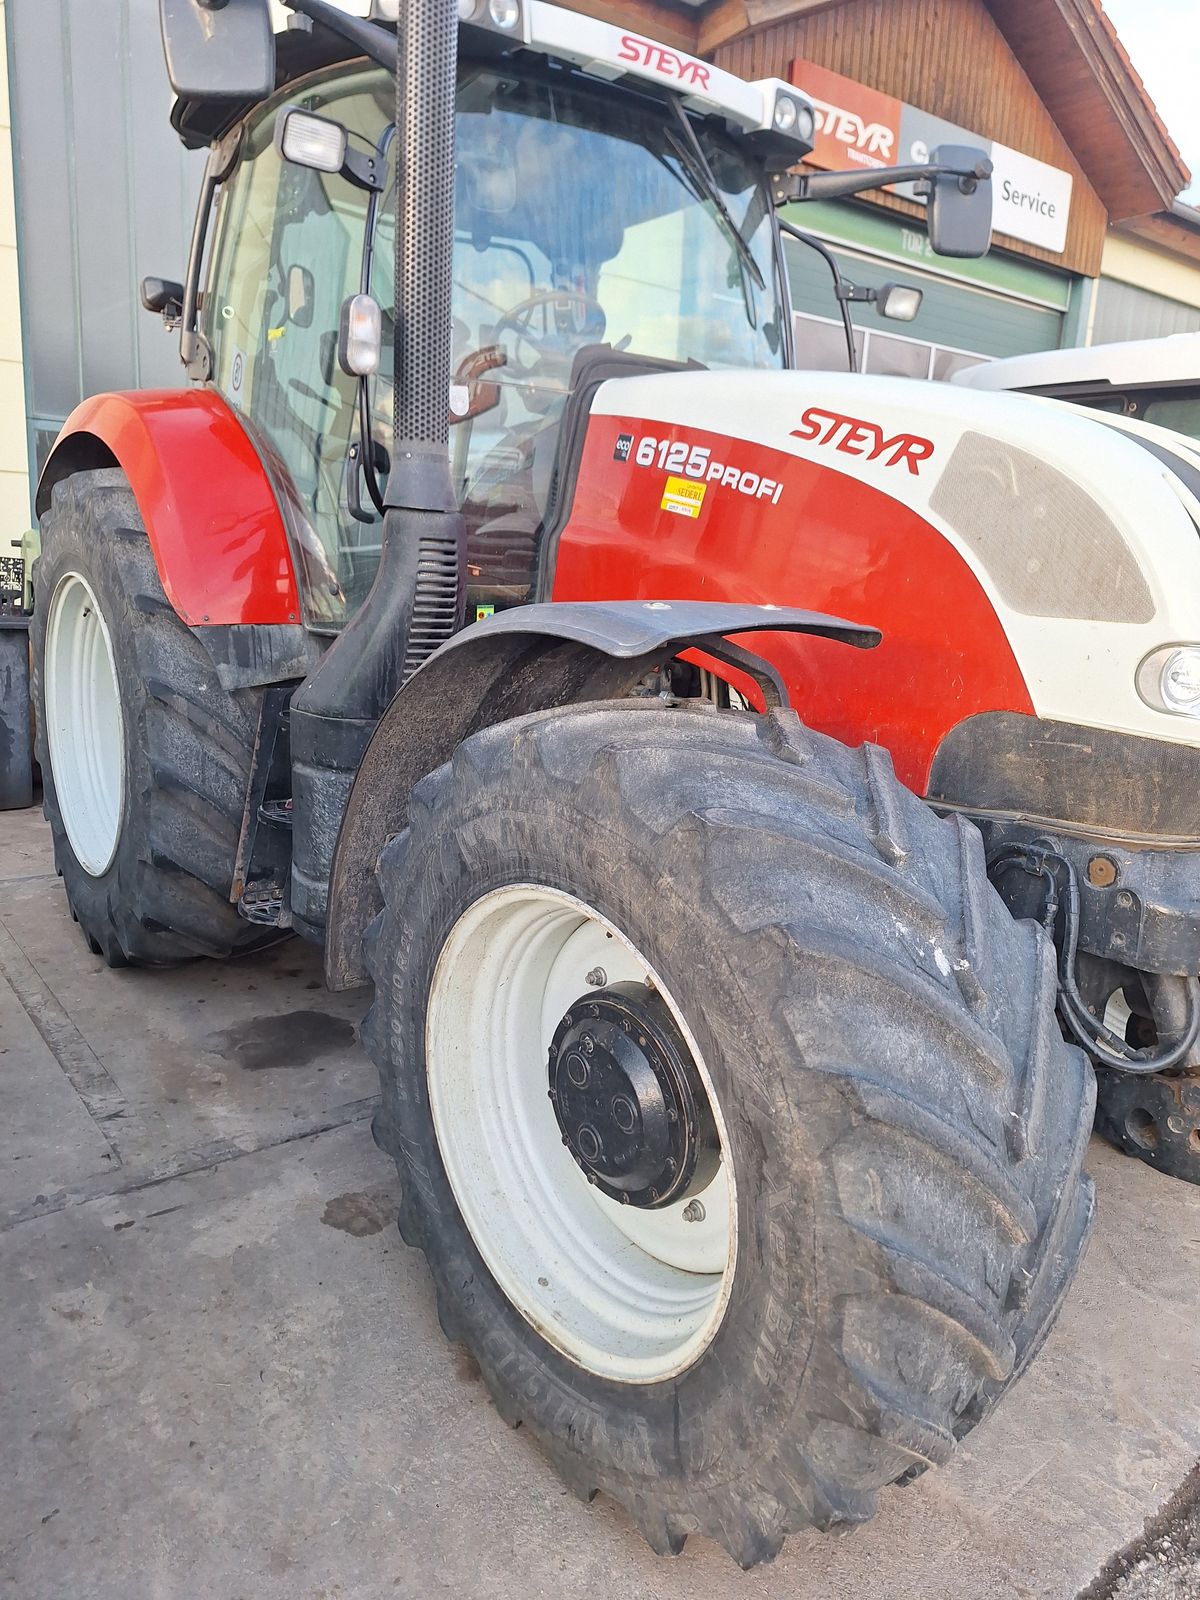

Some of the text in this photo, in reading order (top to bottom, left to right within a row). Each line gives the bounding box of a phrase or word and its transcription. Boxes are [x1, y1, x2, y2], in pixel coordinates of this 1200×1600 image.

[618, 36, 710, 91] STEYR
[1002, 180, 1056, 219] Service
[635, 436, 784, 505] 6125 PROFI
[788, 406, 935, 477] STEYR
